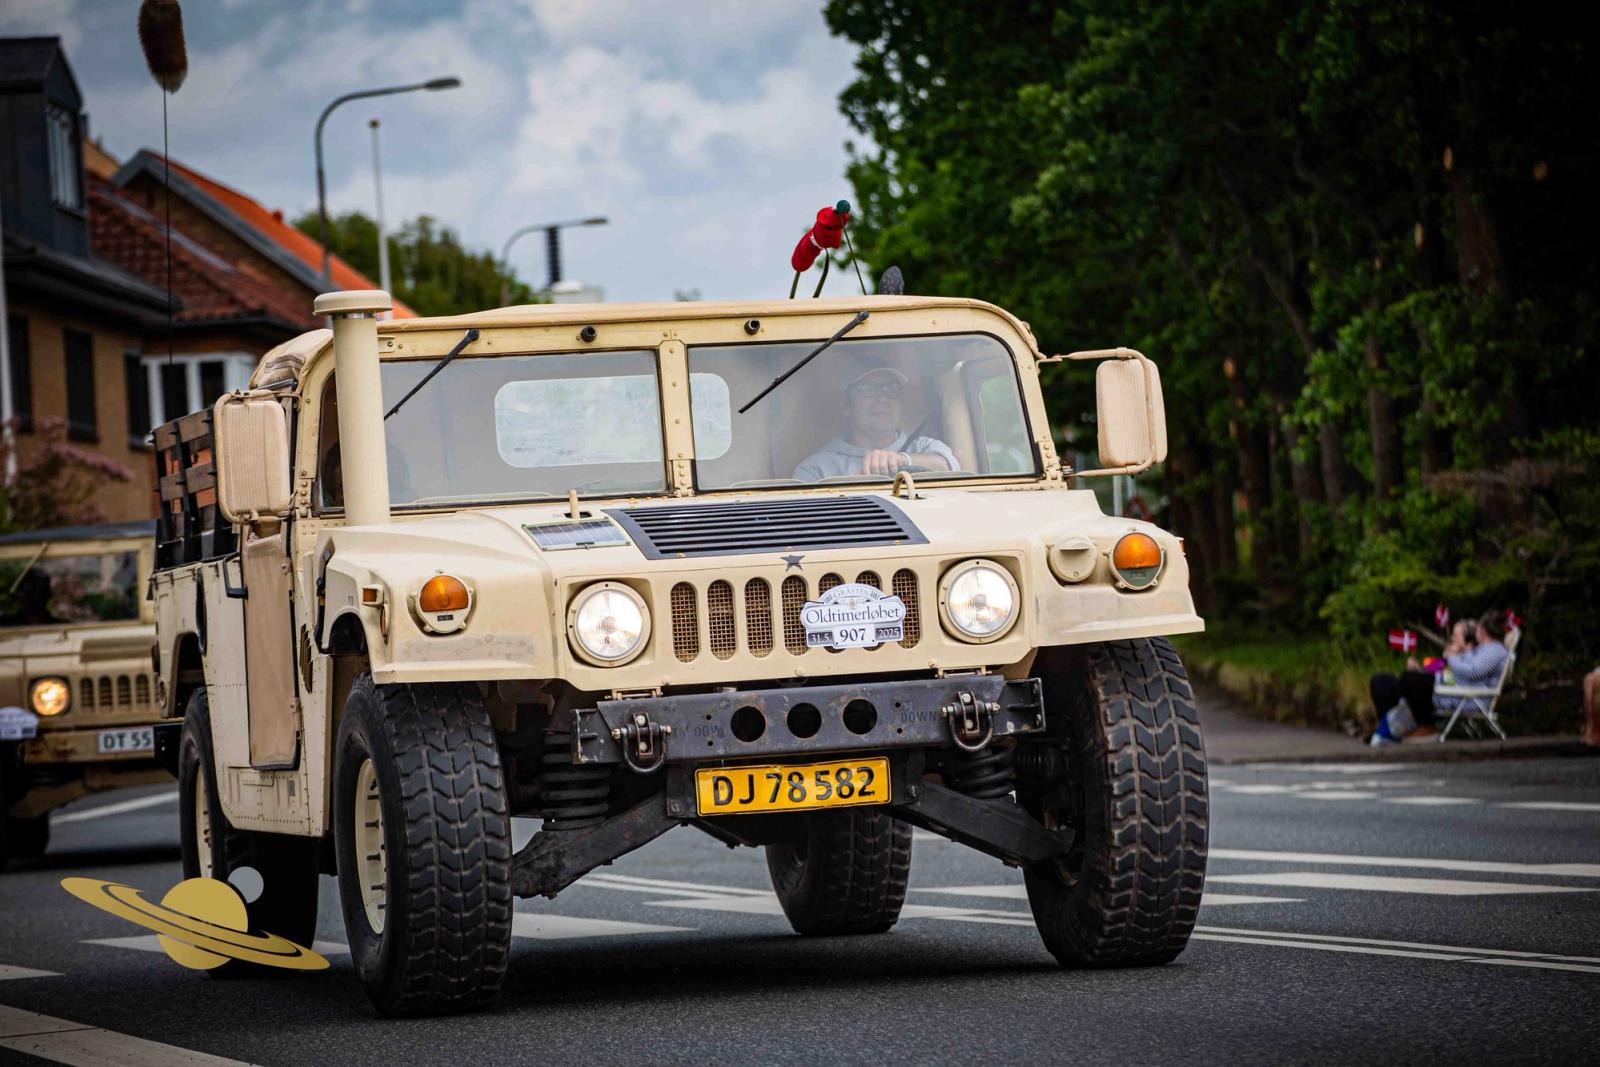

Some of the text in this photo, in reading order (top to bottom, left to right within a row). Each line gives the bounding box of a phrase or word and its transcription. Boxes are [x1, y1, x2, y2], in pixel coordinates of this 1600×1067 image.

[806, 605, 900, 624] Oldtimerløbet
[840, 628, 866, 642] 907
[878, 627, 899, 639] 2025
[901, 711, 937, 722] DOWN
[103, 731, 151, 749] DT 55
